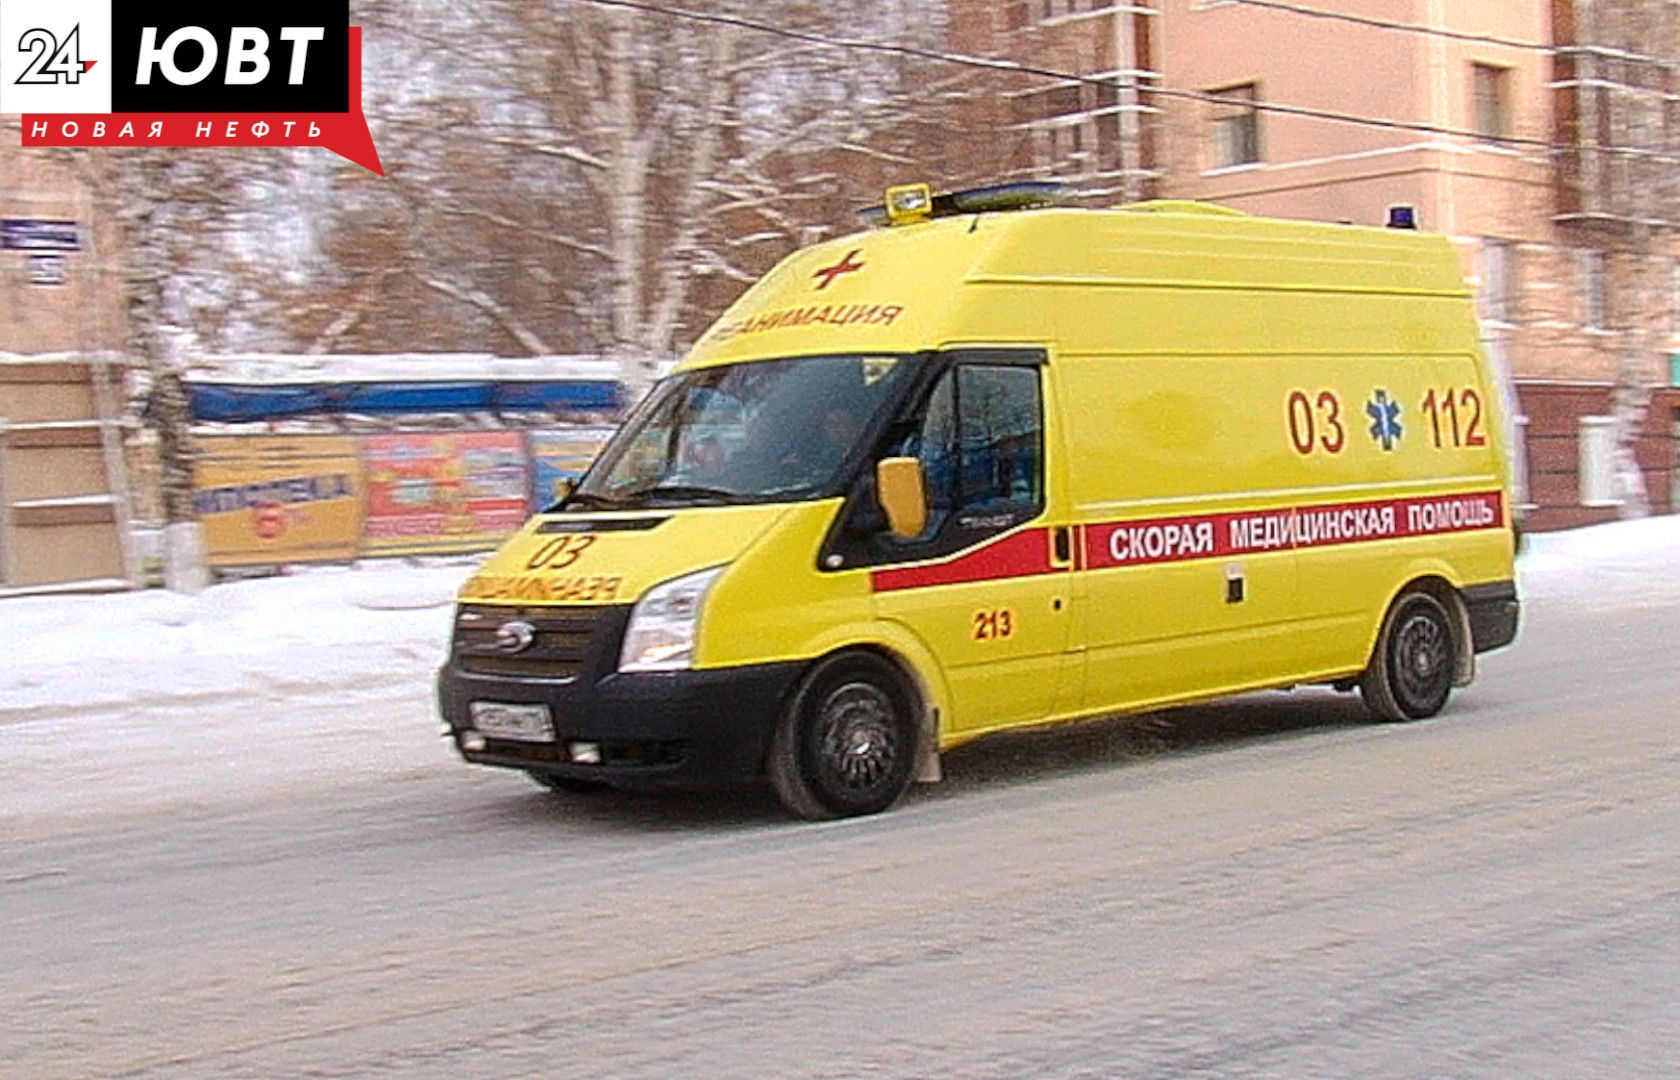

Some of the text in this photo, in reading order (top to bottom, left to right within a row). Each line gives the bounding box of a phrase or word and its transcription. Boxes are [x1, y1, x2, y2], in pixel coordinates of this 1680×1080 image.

[1288, 388, 1486, 453] 03 112
[527, 535, 597, 570] 03
[1110, 497, 1494, 561] СКОРАЯ МЕДИЦИНСКАЯ ПОМОЩЬ
[973, 610, 1012, 639] 213
